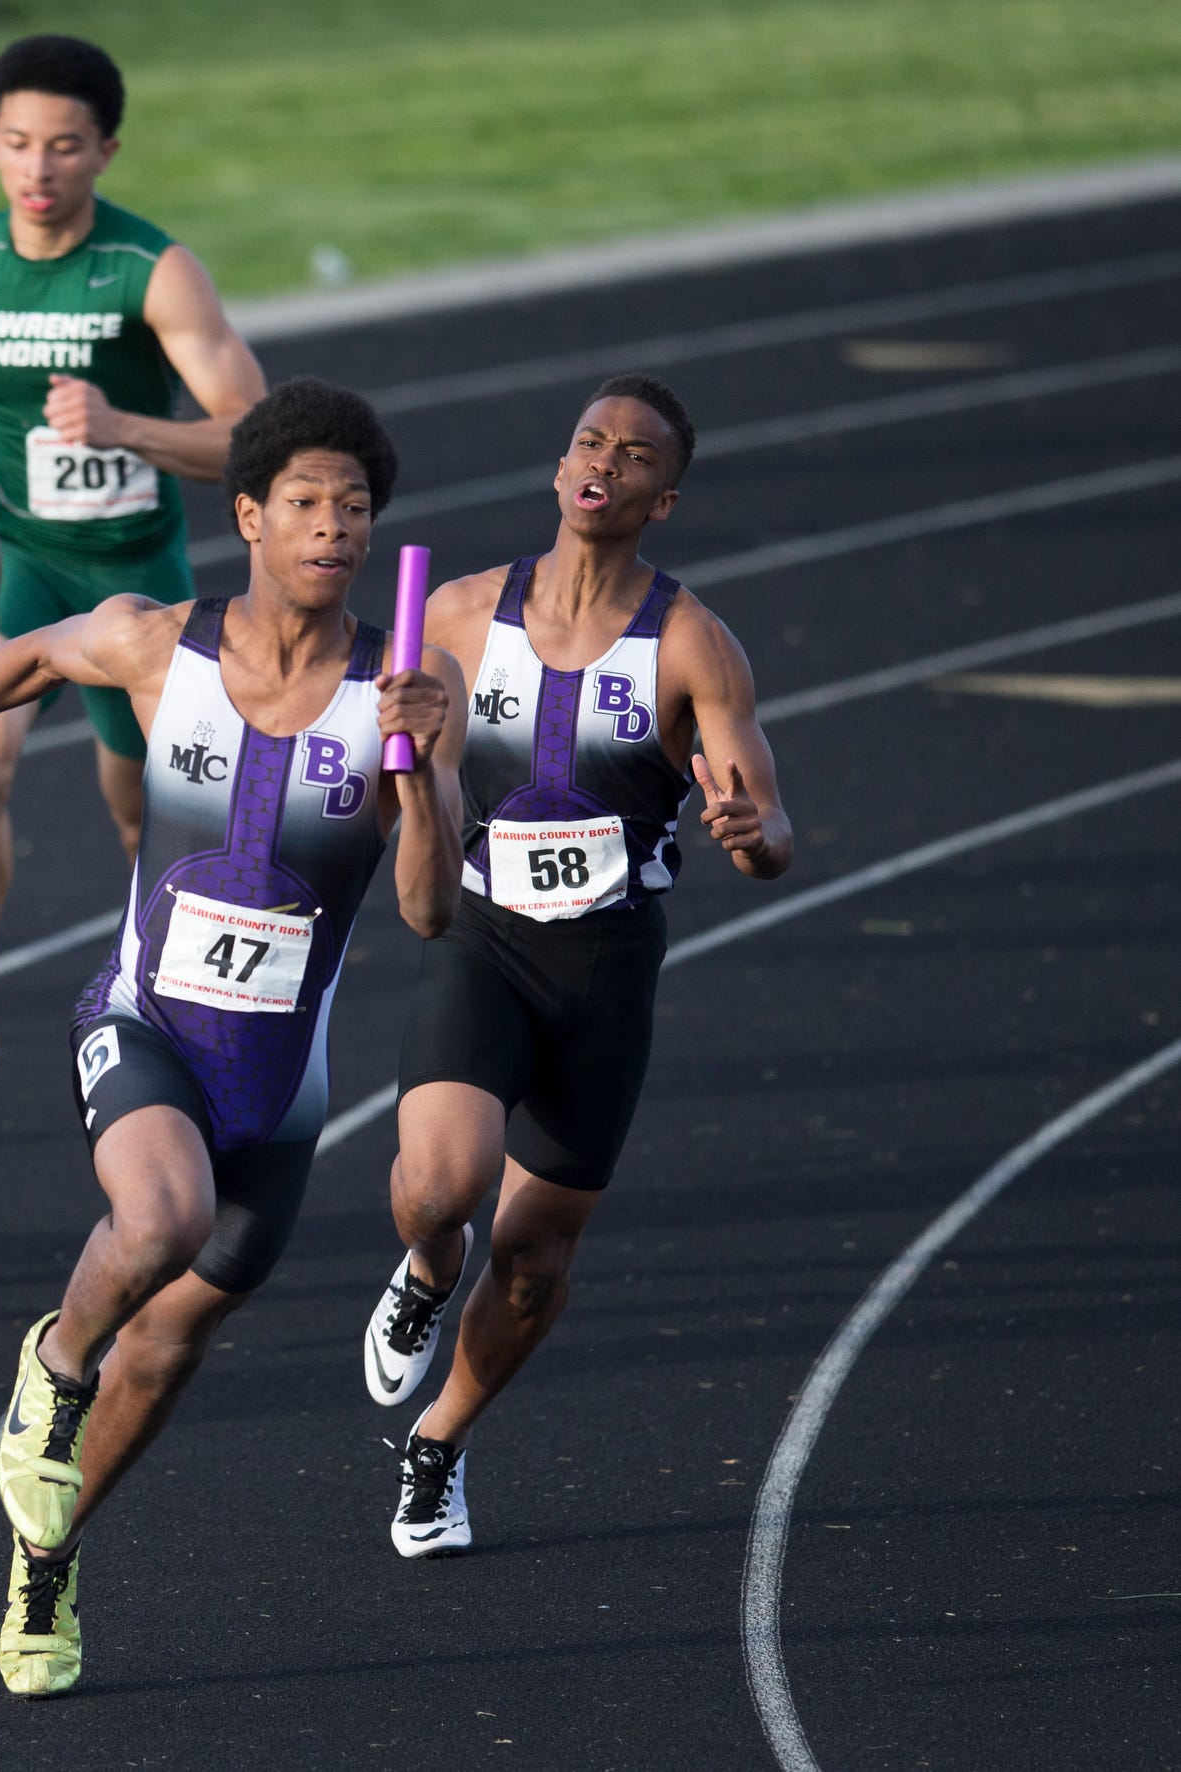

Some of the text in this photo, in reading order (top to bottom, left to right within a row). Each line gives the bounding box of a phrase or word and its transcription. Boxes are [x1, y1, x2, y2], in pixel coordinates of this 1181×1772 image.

[54, 455, 128, 491] 201
[475, 689, 520, 725] MIC
[593, 671, 654, 744] BD
[169, 744, 228, 785] MIC
[301, 731, 369, 820] BD
[492, 826, 620, 841] MARION COUNTY BOYS
[528, 847, 590, 892] 58
[178, 902, 310, 938] MARION COUNTY BOYS
[528, 900, 569, 911] CENTRAL
[571, 897, 593, 906] HIGH
[204, 933, 270, 983] 47
[160, 974, 191, 989] NORTH
[194, 984, 234, 997] CENTRAL
[260, 997, 295, 1006] SCHOOL
[82, 1031, 109, 1087] 5
